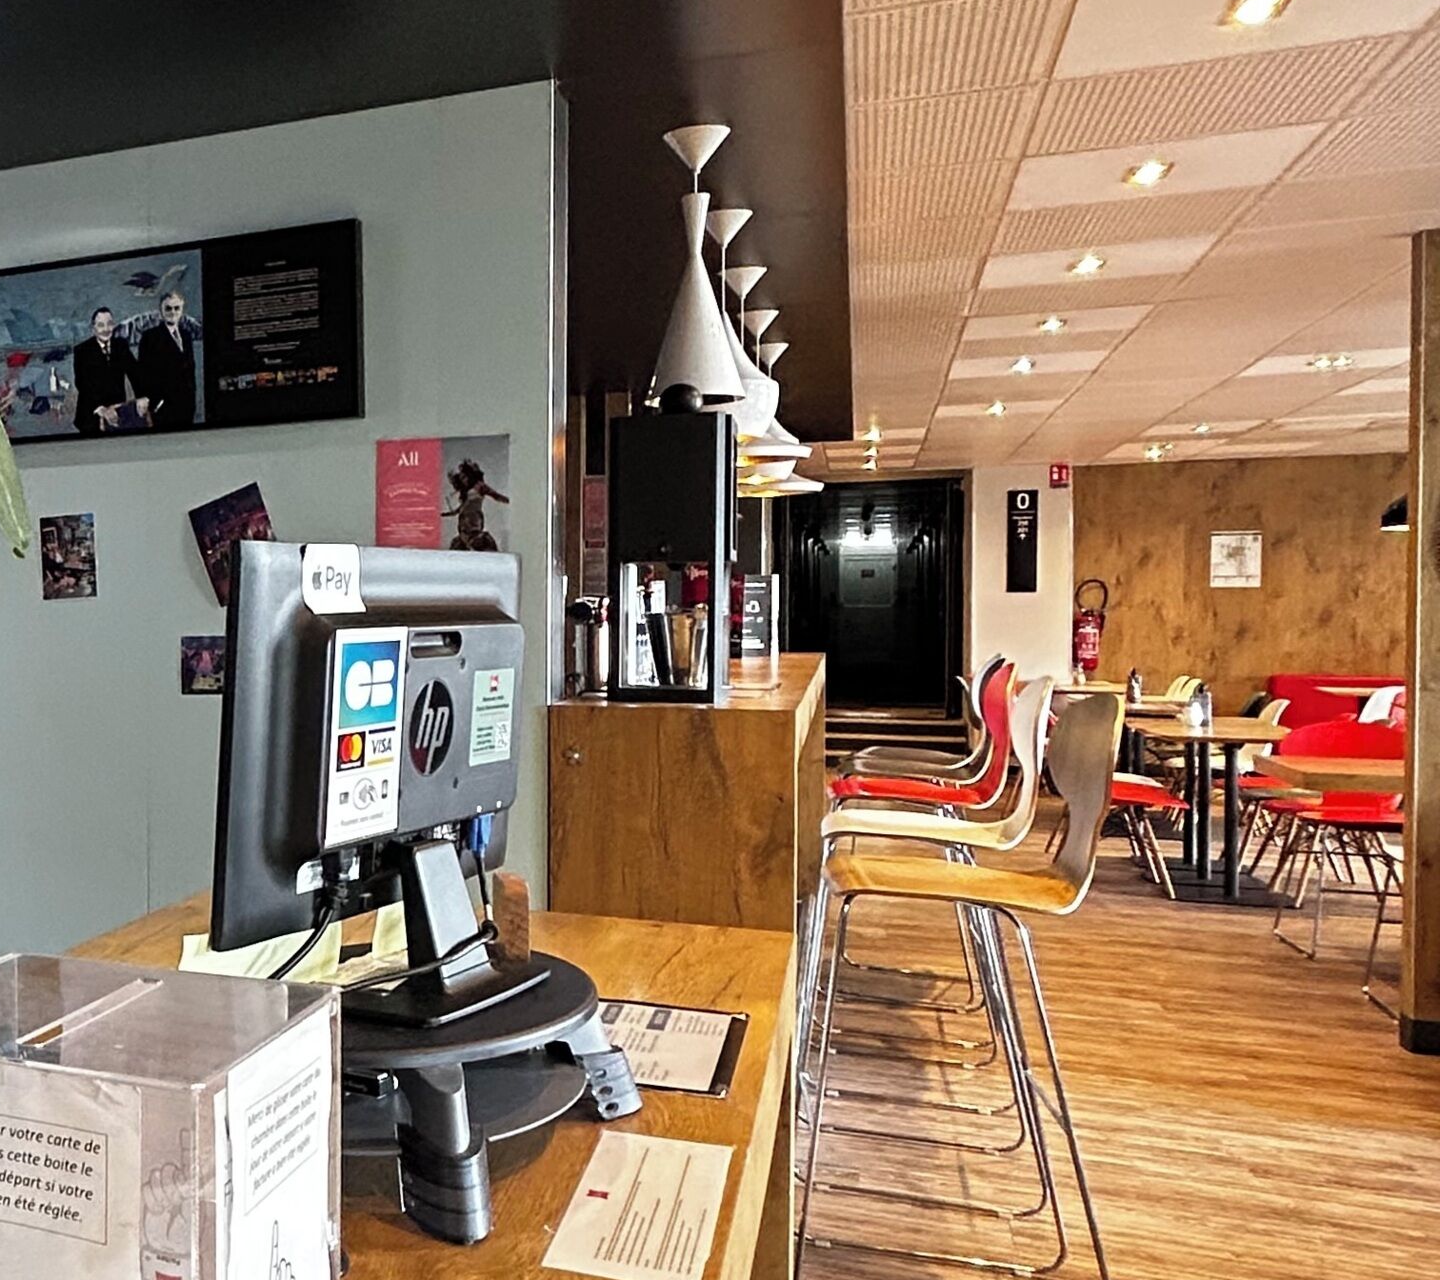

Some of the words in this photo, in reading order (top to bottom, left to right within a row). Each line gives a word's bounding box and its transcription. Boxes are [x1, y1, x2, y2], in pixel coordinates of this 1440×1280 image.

[397, 451, 419, 466] All
[325, 566, 352, 596] Pay
[371, 737, 392, 754] VISA
[9, 1127, 44, 1143] votre
[47, 1133, 82, 1151] carte
[84, 1139, 101, 1155] de
[7, 1151, 41, 1166] cette
[81, 1162, 93, 1177] le
[44, 1181, 55, 1192] si
[59, 1183, 94, 1200] votre
[14, 1195, 36, 1211] été
[39, 1203, 82, 1223] réglée.
